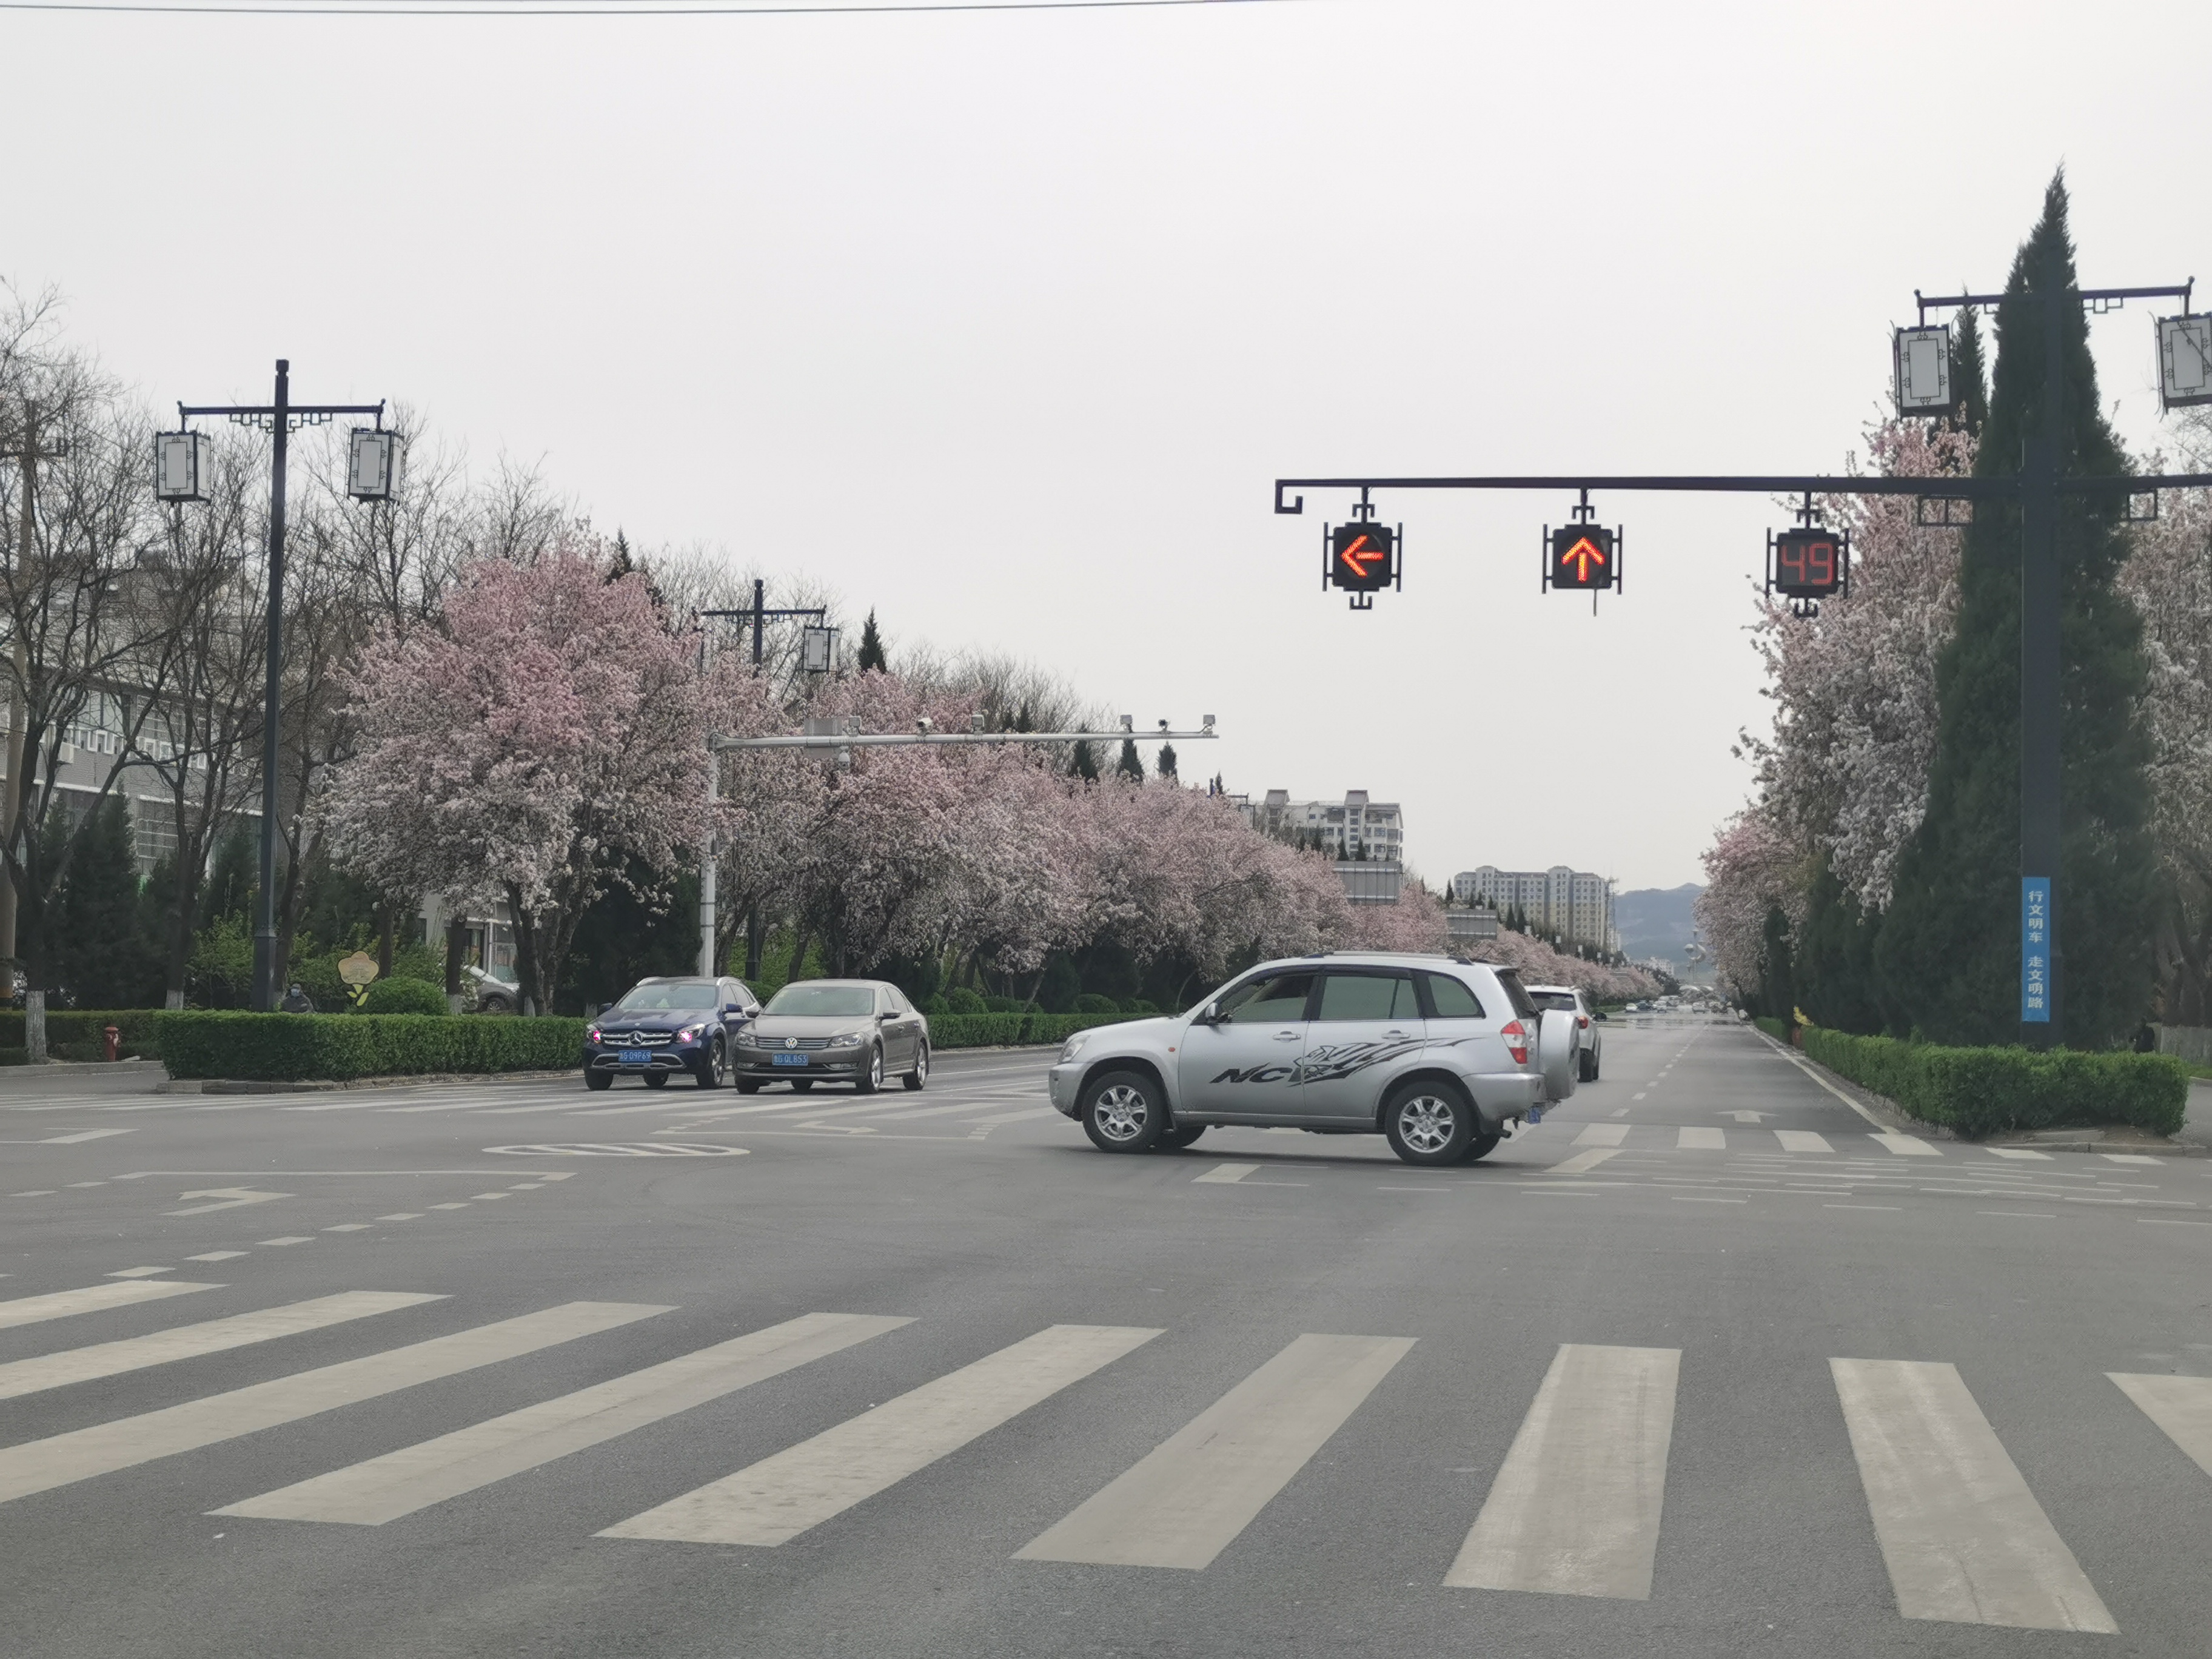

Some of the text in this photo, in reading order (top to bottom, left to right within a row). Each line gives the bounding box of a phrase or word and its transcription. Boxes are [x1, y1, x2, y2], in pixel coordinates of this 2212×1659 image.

[1781, 543, 1834, 585] 49
[2028, 890, 2044, 1009] 行文明车 走文明路
